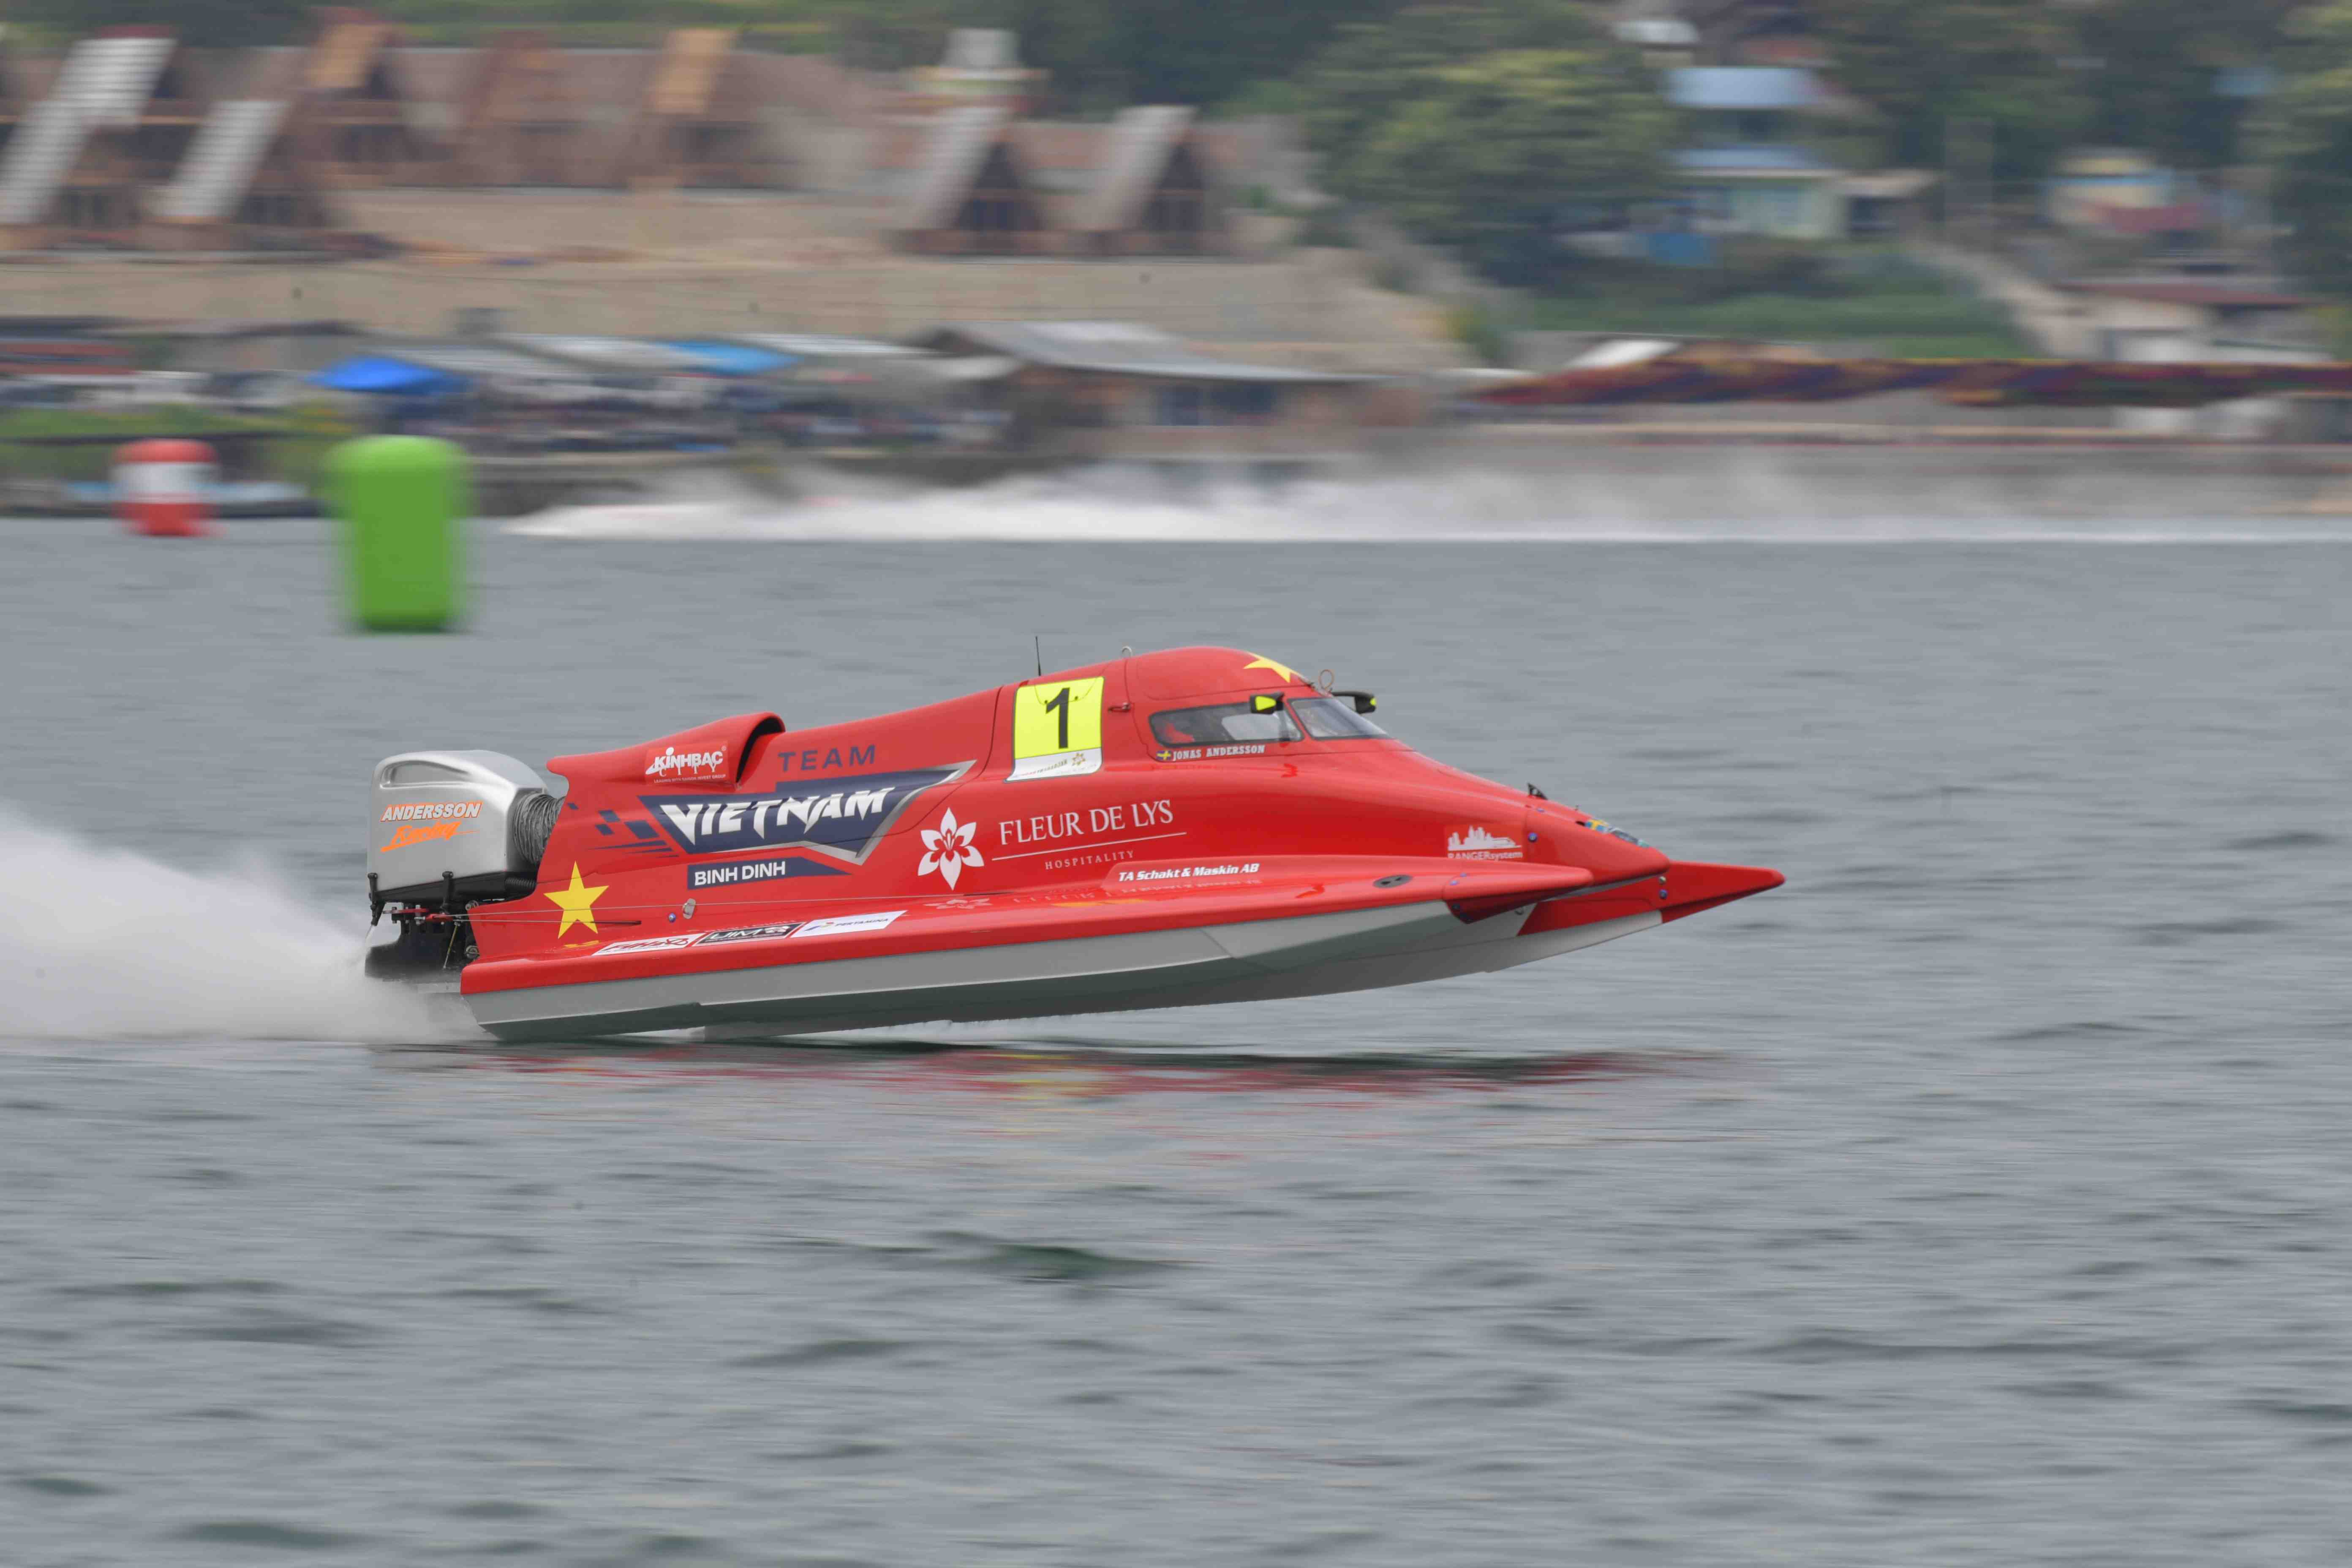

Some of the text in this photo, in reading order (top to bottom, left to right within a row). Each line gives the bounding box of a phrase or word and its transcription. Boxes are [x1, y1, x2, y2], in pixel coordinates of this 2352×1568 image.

[1045, 687, 1070, 749] 1
[778, 745, 876, 772] TEAM
[1173, 744, 1266, 761] JONAS ANDERSSON
[380, 800, 482, 822] ANDERSSON
[660, 787, 896, 845] VIETNAM
[999, 800, 1173, 845] FLEUR DE LYS
[381, 820, 462, 852] Racing
[1045, 850, 1135, 870] HOSPITALITY
[694, 861, 786, 885] BINH DINH
[1119, 863, 1260, 882] TA Schakt & Maskin AB
[835, 918, 889, 927] PERTAMINA
